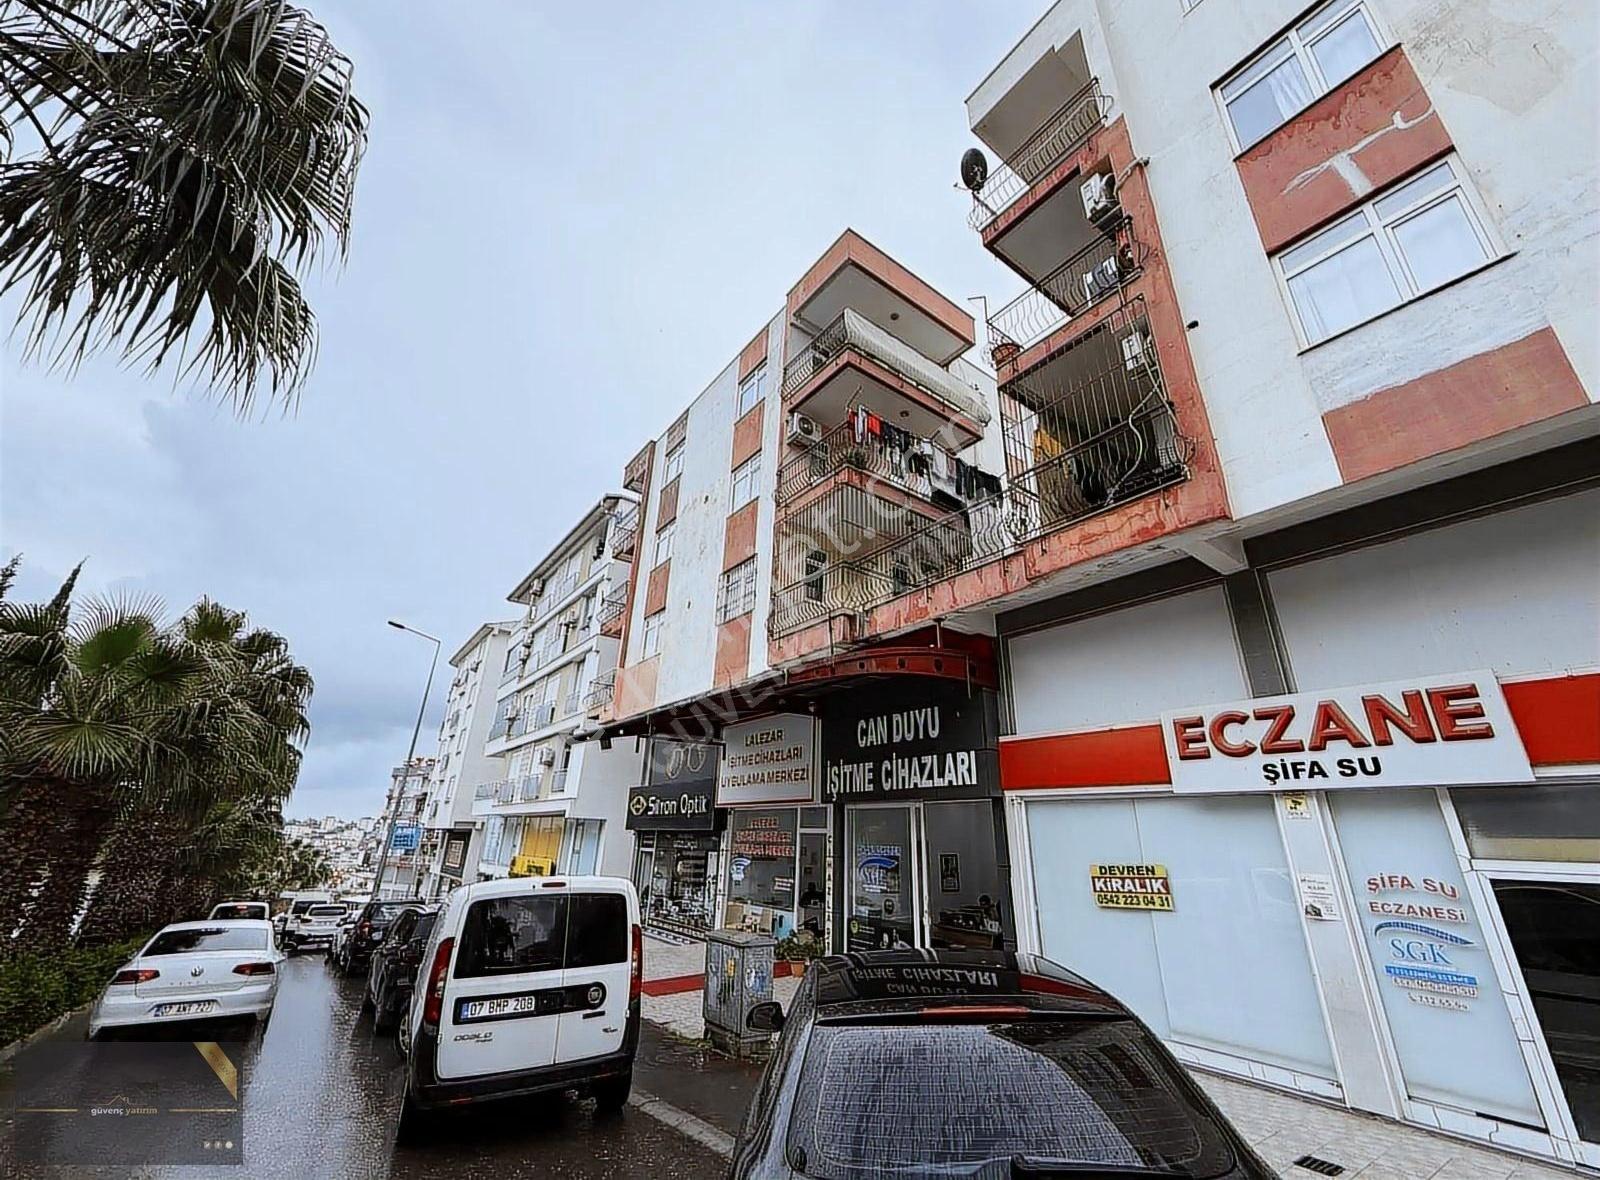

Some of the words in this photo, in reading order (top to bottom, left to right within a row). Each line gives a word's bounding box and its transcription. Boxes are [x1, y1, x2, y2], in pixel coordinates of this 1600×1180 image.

[857, 715, 888, 748] CAN
[892, 706, 939, 743] DUYU
[1173, 683, 1495, 760] ECZANE
[744, 729, 784, 747] LALEZAR
[826, 759, 874, 801] İŞİTME
[881, 751, 978, 791] CİHAZLARI
[1262, 758, 1328, 785] ŞİFA
[1336, 756, 1382, 777] SU
[1098, 865, 1156, 876] DEVREN
[1367, 872, 1416, 893] ŞİFA
[1422, 878, 1458, 899] SU
[1097, 894, 1120, 905] 0542
[1121, 895, 1141, 906] 223
[1142, 895, 1156, 907] 04
[1157, 896, 1171, 908] 31
[1390, 938, 1453, 965] SGK
[469, 1002, 484, 1016] 07
[513, 997, 534, 1011] 208
